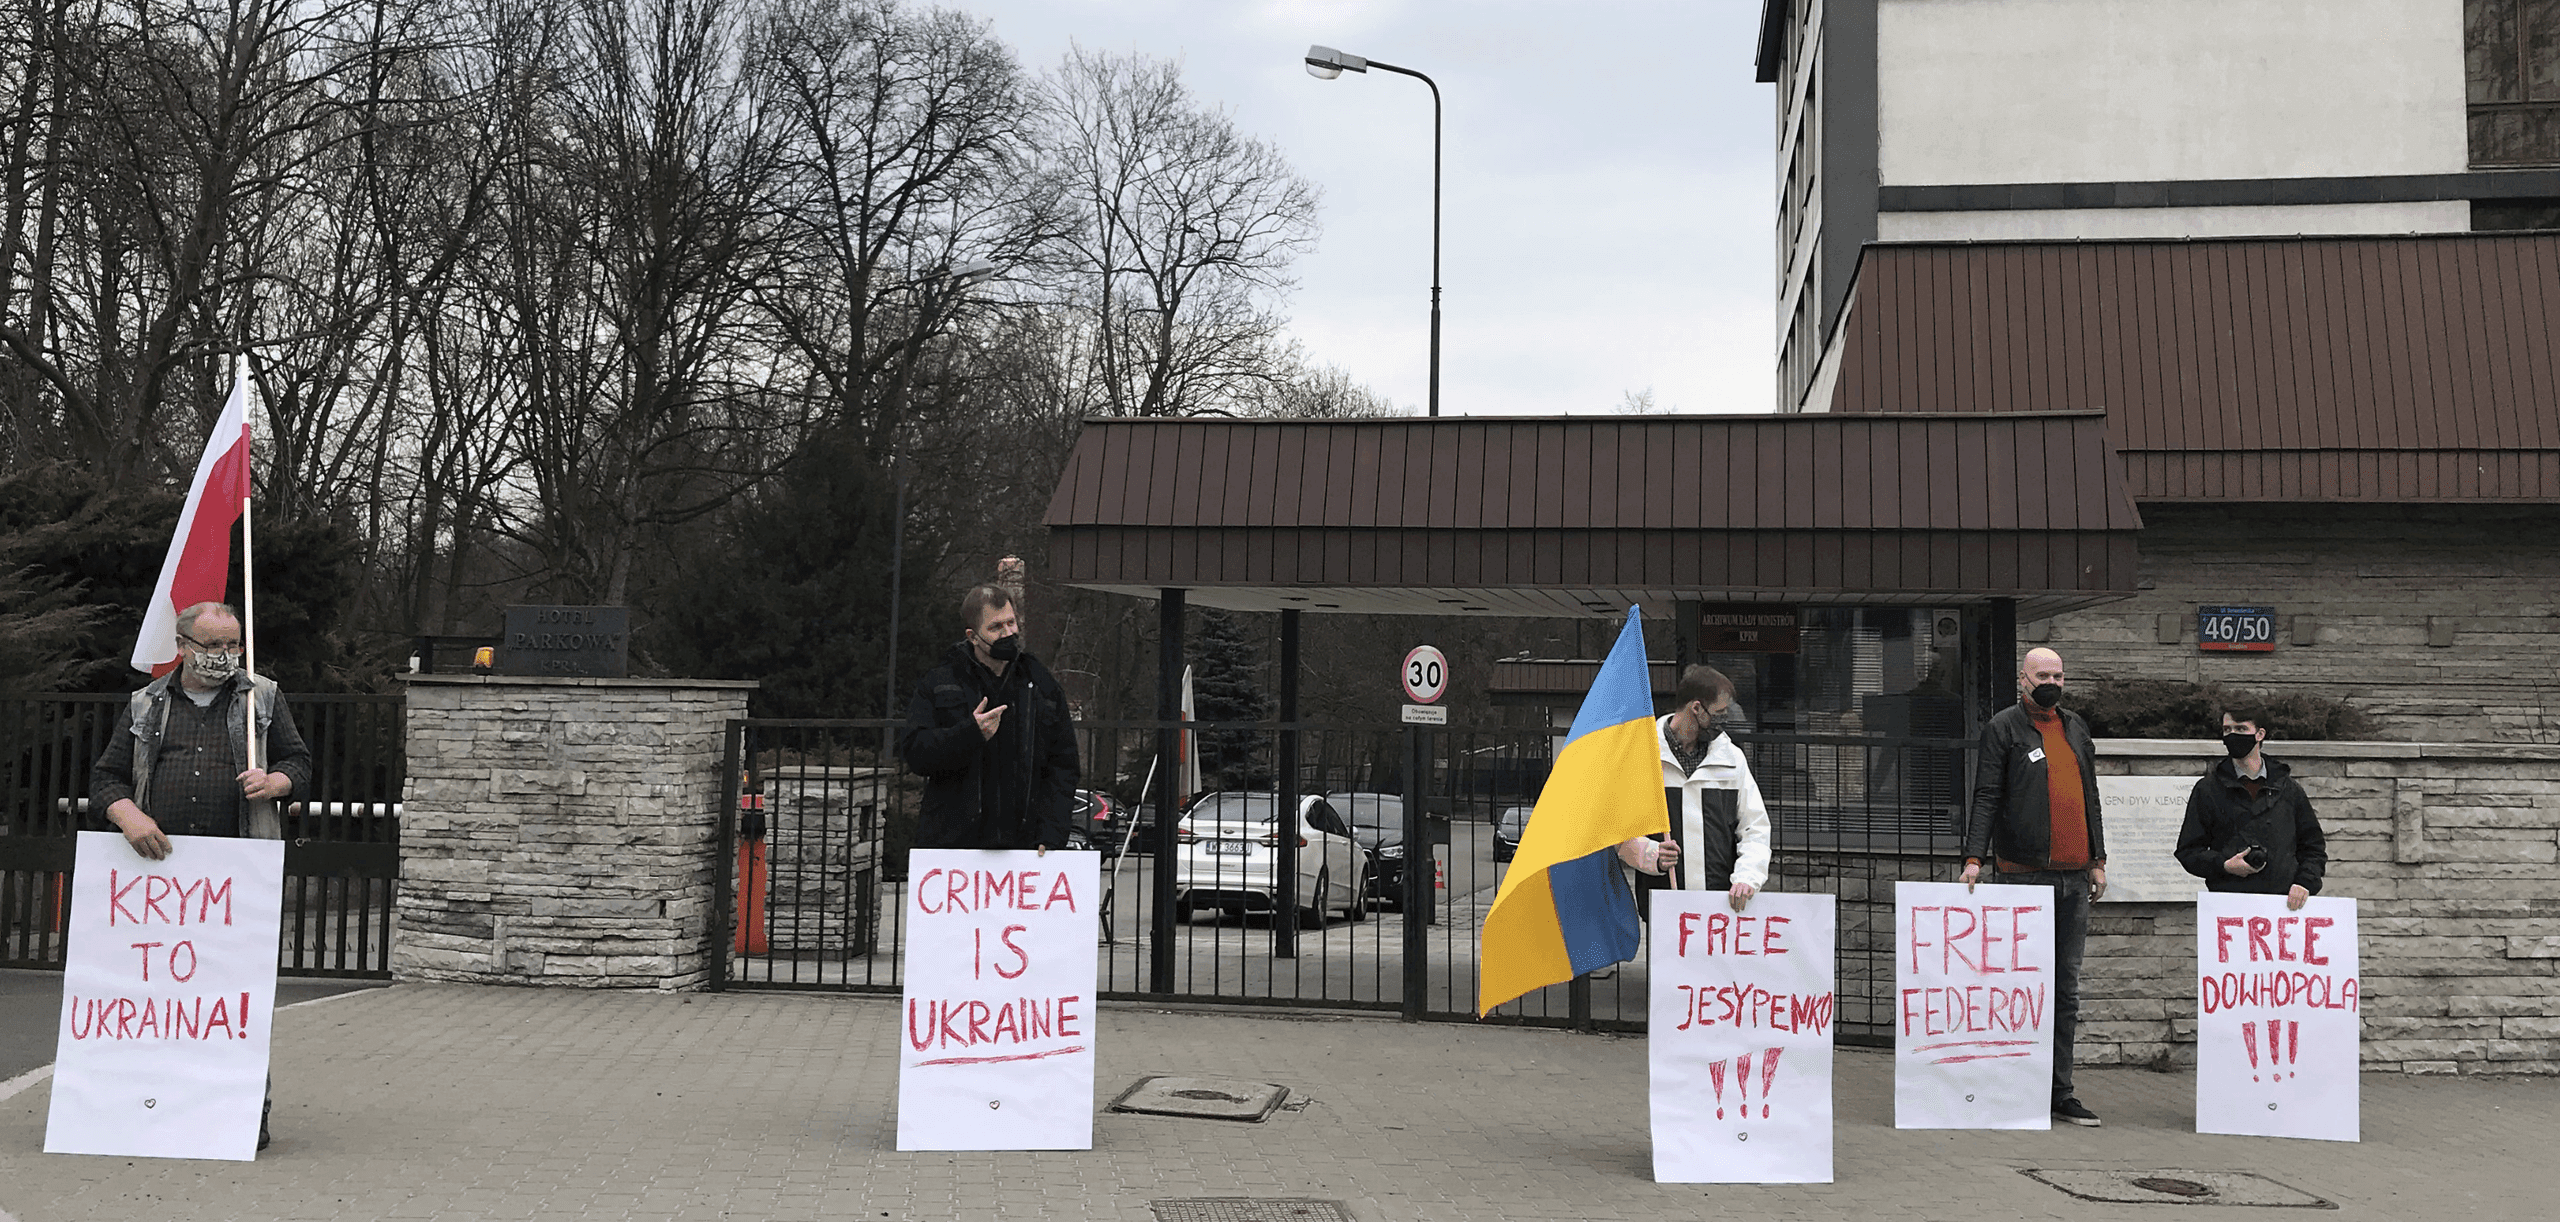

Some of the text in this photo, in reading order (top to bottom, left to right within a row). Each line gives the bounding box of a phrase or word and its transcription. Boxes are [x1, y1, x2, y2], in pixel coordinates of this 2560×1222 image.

[537, 609, 595, 625] HOTEL
[1702, 613, 1738, 626] ARCHIWUM
[1739, 614, 1757, 626] RADY
[2204, 616, 2270, 643] 46/50
[1409, 660, 1442, 688] 30
[2104, 796, 2125, 806] GEN
[2129, 796, 2150, 806] DYW
[109, 868, 233, 931] KRYM
[917, 867, 1076, 914] CRIMEA
[974, 924, 1029, 981] IS
[1678, 911, 1791, 958] FREE
[1911, 905, 2042, 977] FREE
[2216, 916, 2335, 966] FREE
[130, 939, 197, 984] TO
[1676, 982, 1833, 1037] JESYPENKO
[1902, 982, 2045, 1037] FEDEROV
[2202, 970, 2358, 1014] DOWHOPOLA
[71, 991, 250, 1041] UKRAINA!
[908, 995, 1081, 1052] UKRAINE
